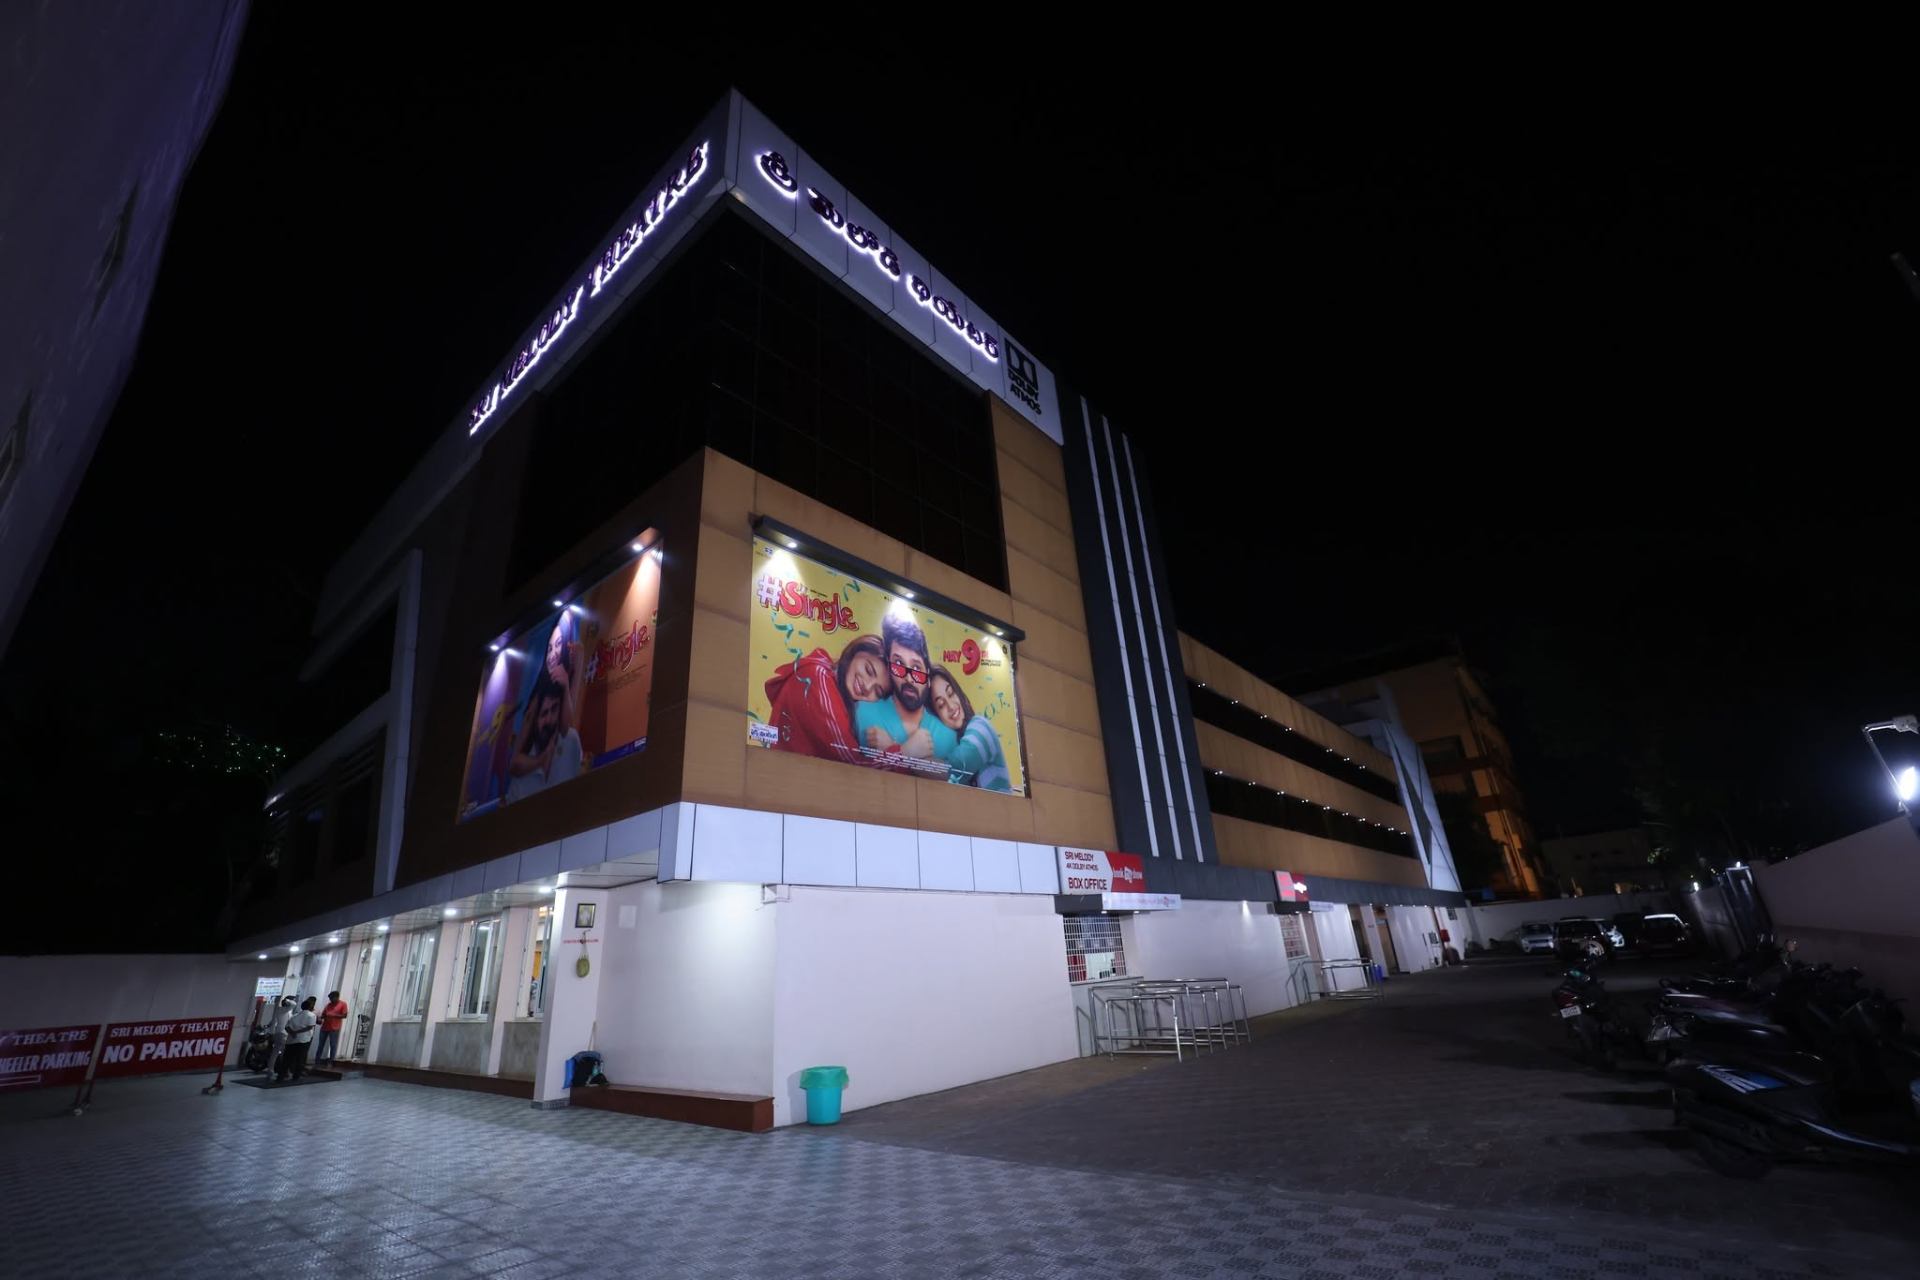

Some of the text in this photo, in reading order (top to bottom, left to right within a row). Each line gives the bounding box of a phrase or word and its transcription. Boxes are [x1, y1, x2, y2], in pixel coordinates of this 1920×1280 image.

[1010, 383, 1042, 415] ATMOS
[1068, 876, 1108, 891] BOX OFFICE
[12, 1029, 89, 1046] THEATRE
[110, 1020, 231, 1038] SRI MELODY THEATRE
[40, 1050, 92, 1070] PARKING
[102, 1037, 226, 1064] NO PARKING
